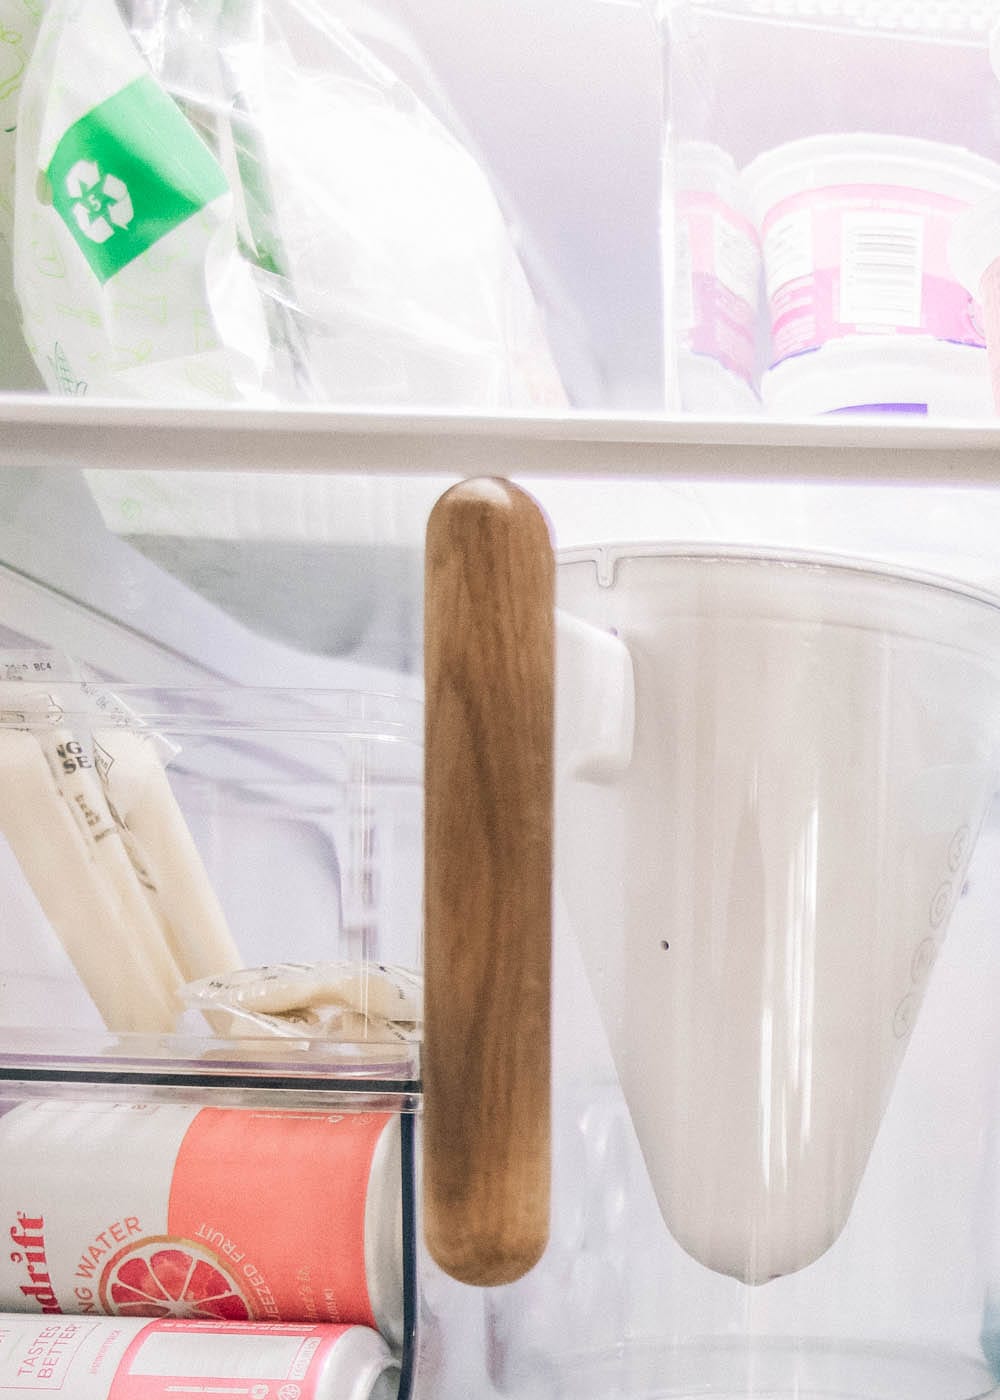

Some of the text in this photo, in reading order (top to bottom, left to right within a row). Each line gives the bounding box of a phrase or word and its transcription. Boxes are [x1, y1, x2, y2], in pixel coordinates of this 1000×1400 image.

[74, 1215, 143, 1278] WATER
[195, 1222, 246, 1267] FRUIT
[17, 1326, 61, 1376] TASTES
[37, 1324, 79, 1379] BETTER
